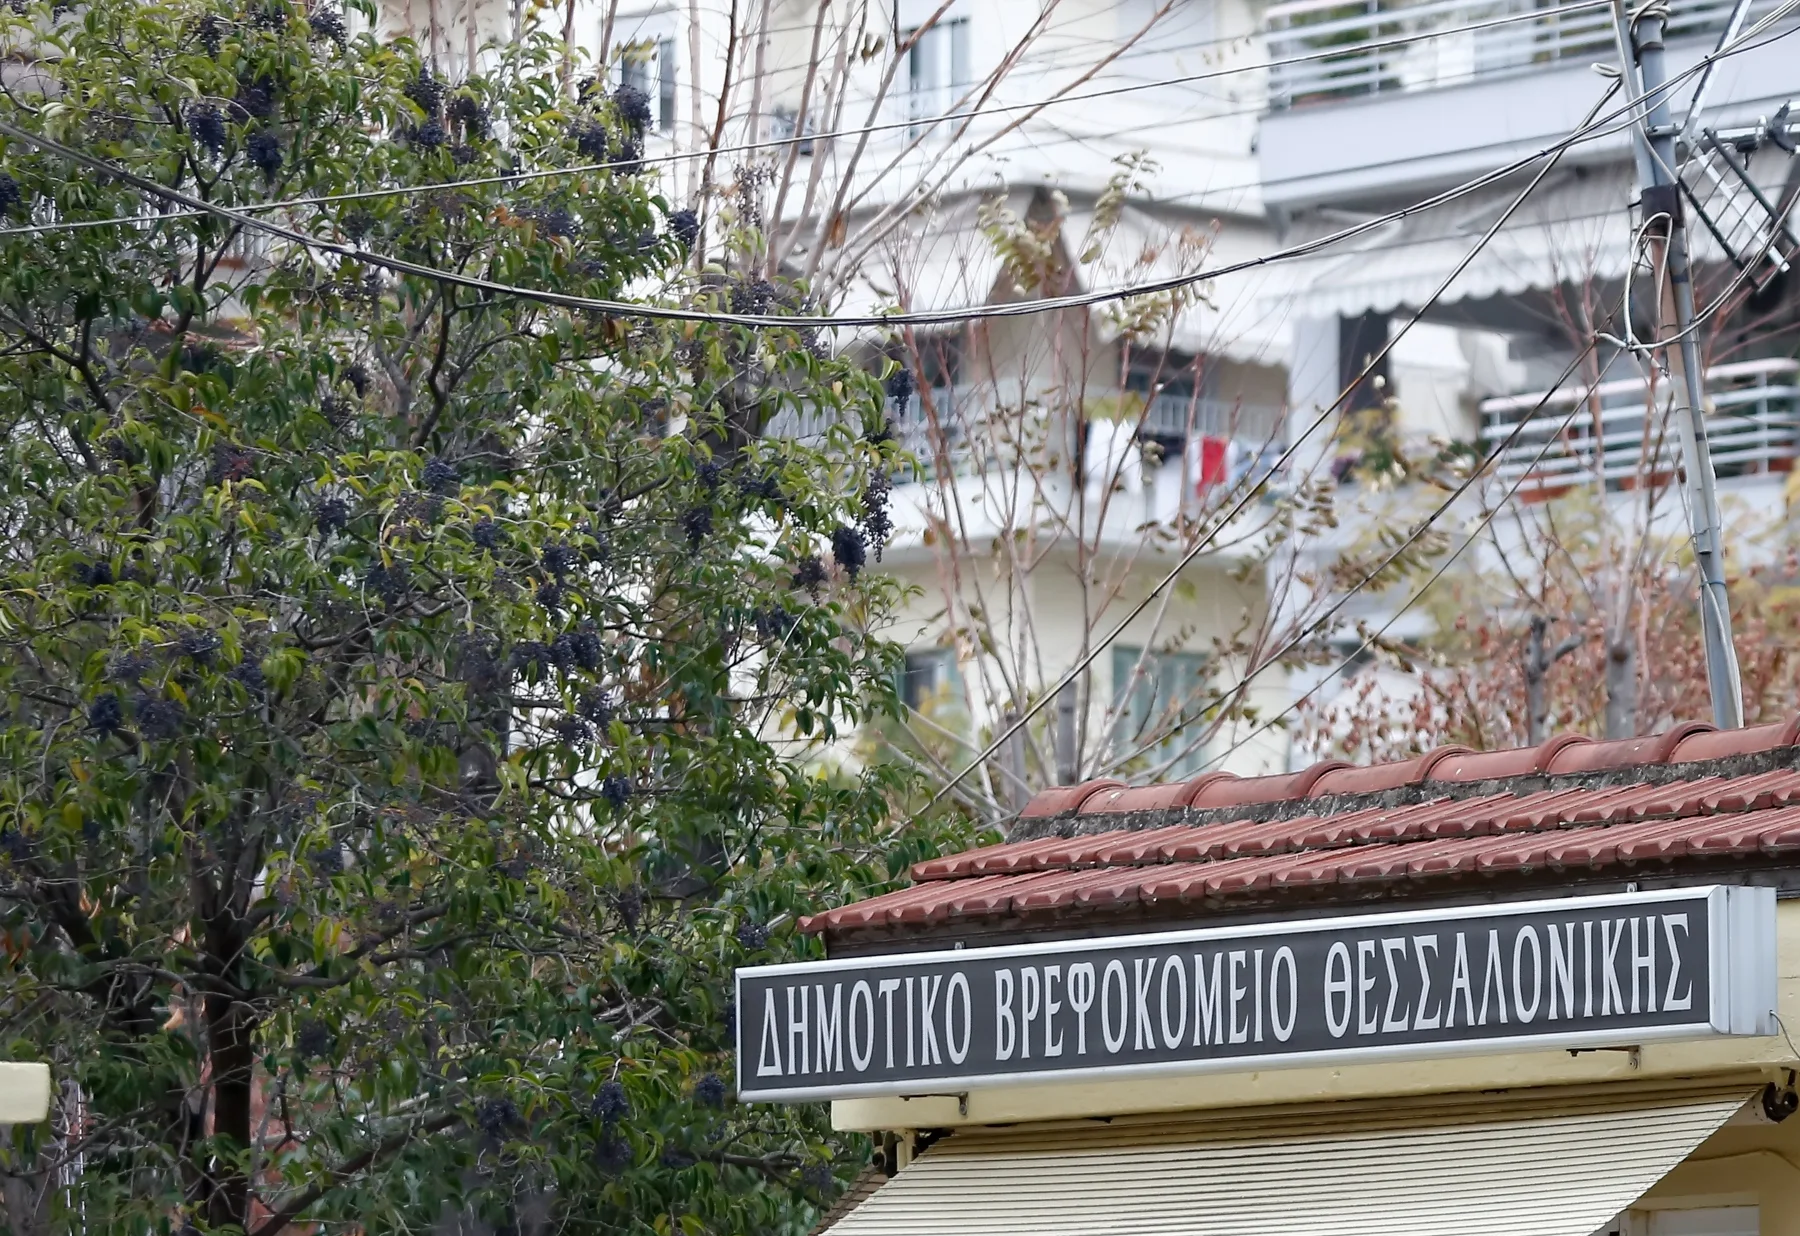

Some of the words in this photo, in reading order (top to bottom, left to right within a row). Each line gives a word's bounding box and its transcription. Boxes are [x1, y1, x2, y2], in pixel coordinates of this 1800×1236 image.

[757, 970, 971, 1077] ΔΗΜΟΤΙΚΟ
[994, 945, 1299, 1061] ΒΡΕΦΟΚΟΜΕΙΟ
[1323, 912, 1693, 1038] ΘΕΣΣΑΛΟΝΙΚΗΣ
